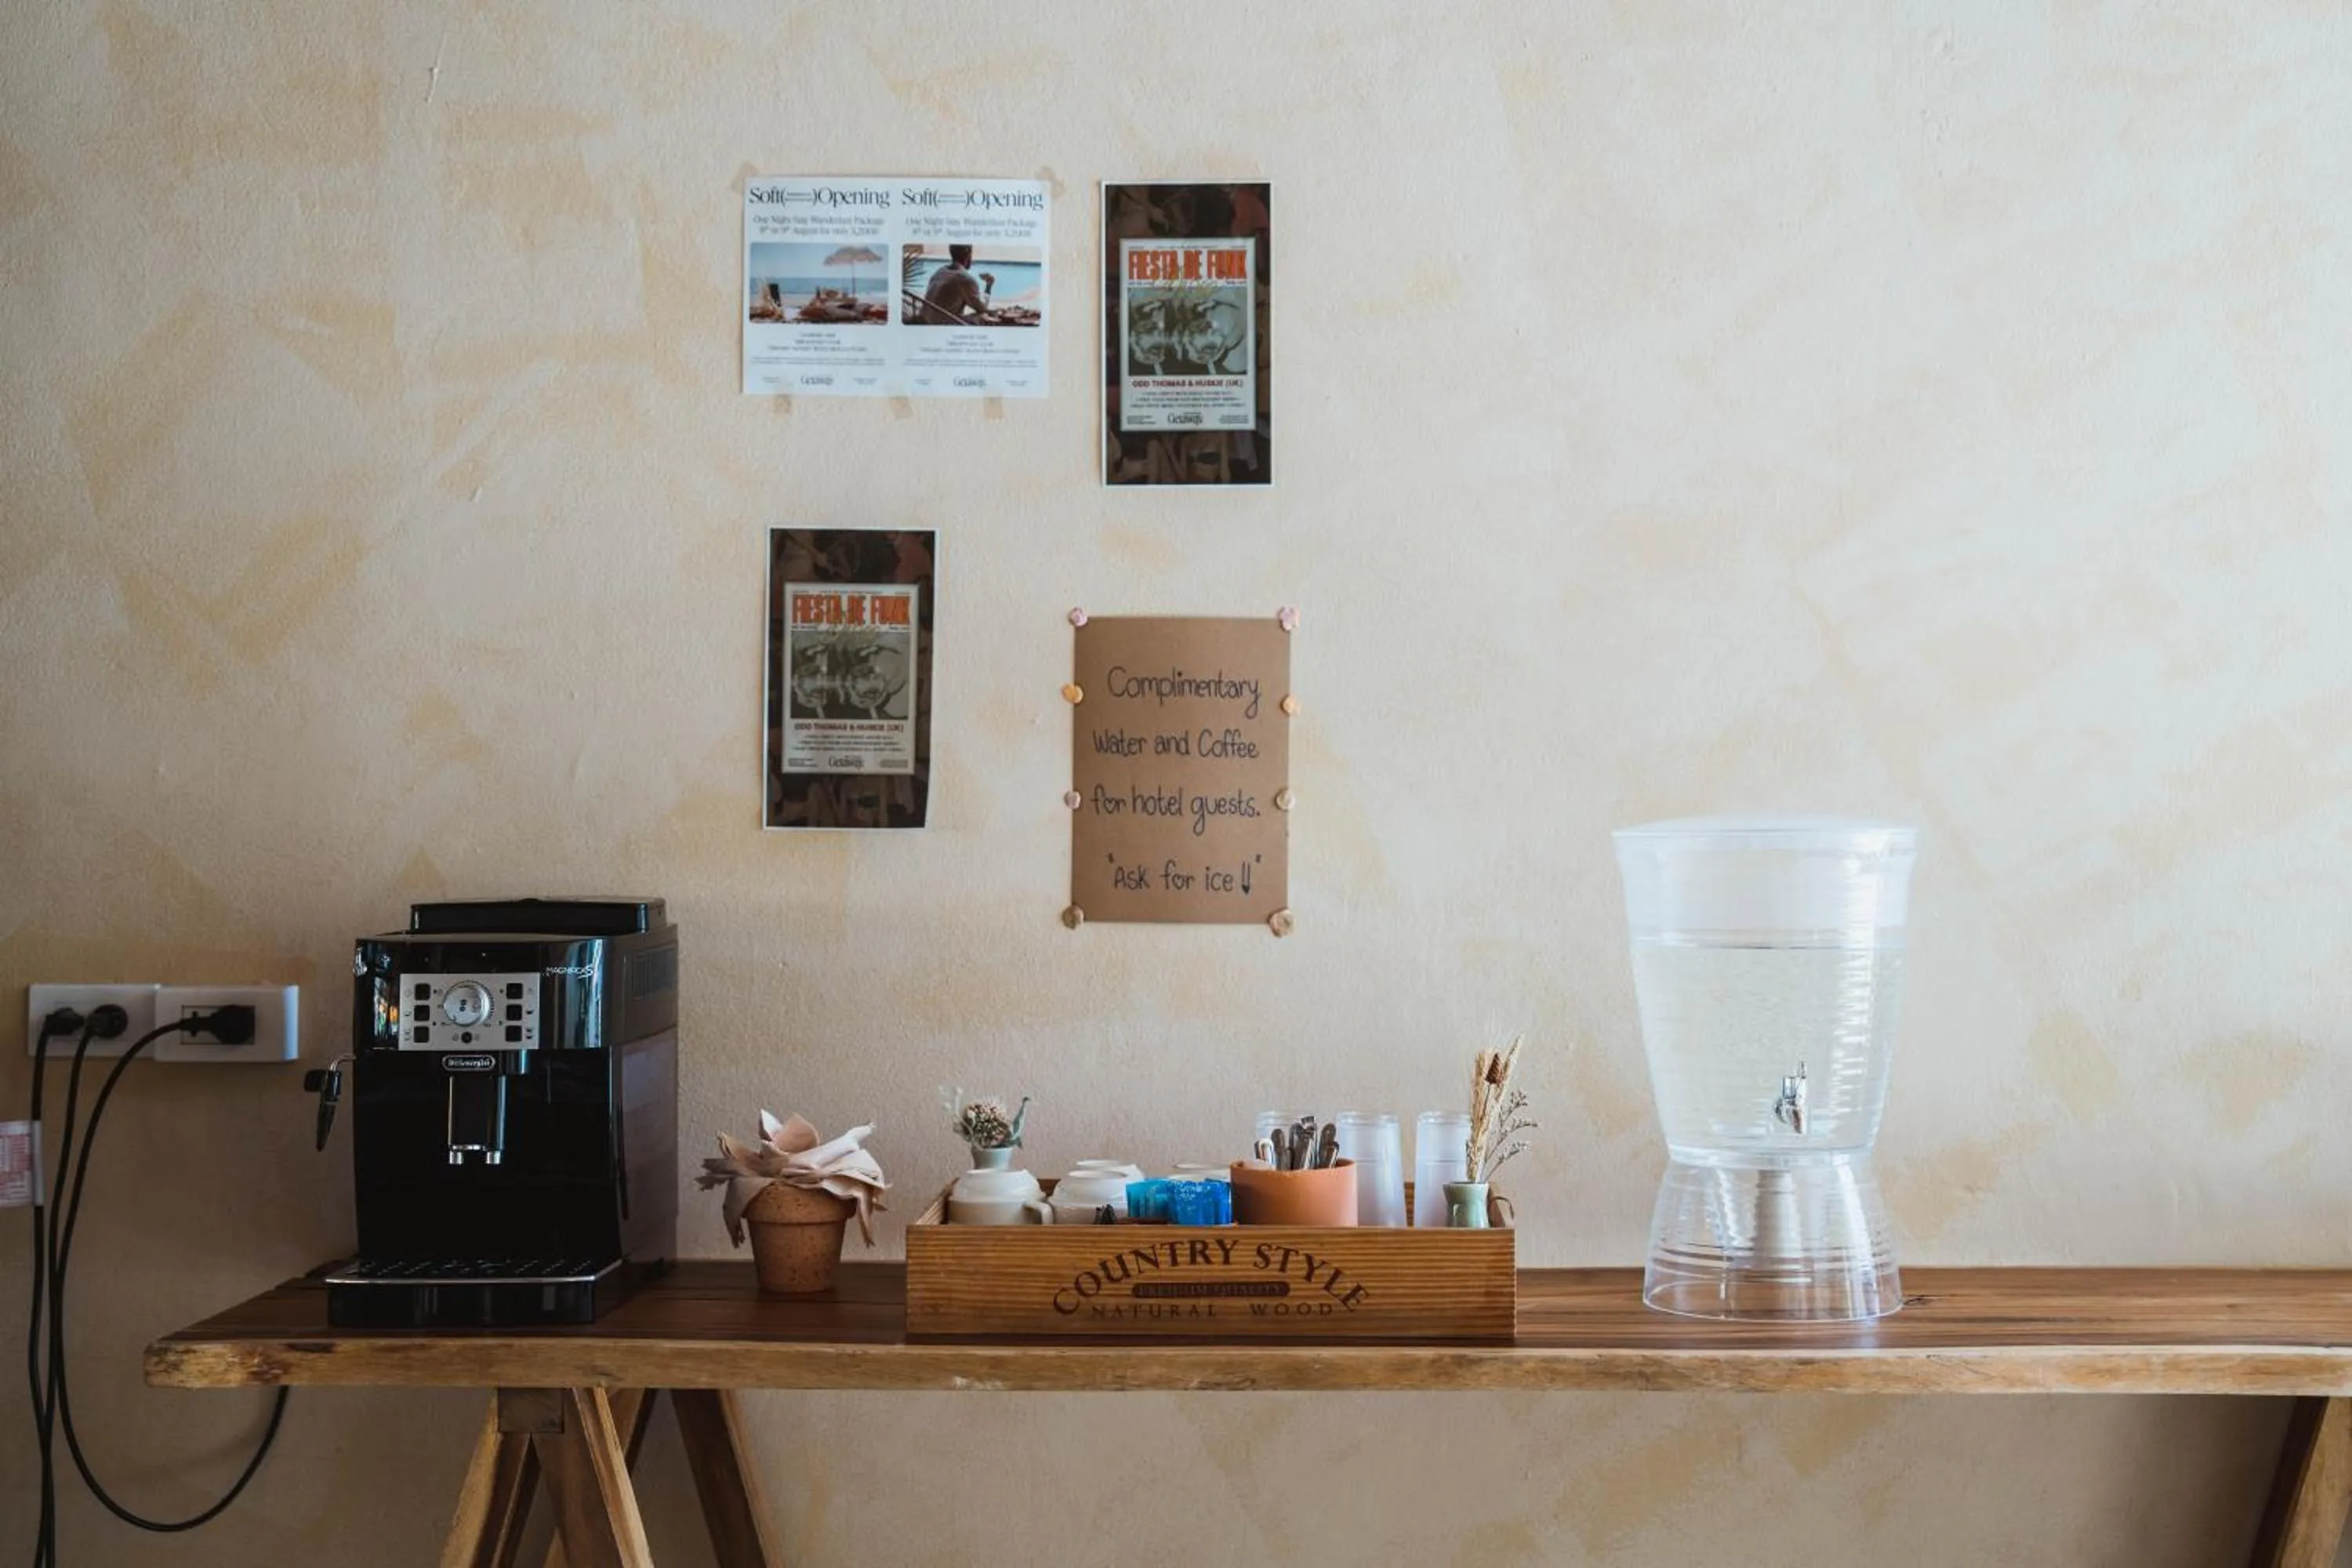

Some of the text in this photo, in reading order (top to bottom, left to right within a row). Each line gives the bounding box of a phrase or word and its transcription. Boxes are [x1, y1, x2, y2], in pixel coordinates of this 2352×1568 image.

[1128, 250, 1180, 281] FIESTA
[1183, 250, 1202, 280] DE
[792, 593, 842, 624] FIESTA
[1107, 666, 1261, 720] Complimentary
[1093, 728, 1261, 759] Water and Coffee
[1091, 783, 1261, 837] for hotel guests.
[1160, 859, 1195, 891] for
[1052, 1239, 1371, 1316] COUNTRY STYLE
[1091, 1302, 1334, 1319] NATURAL WOOD
